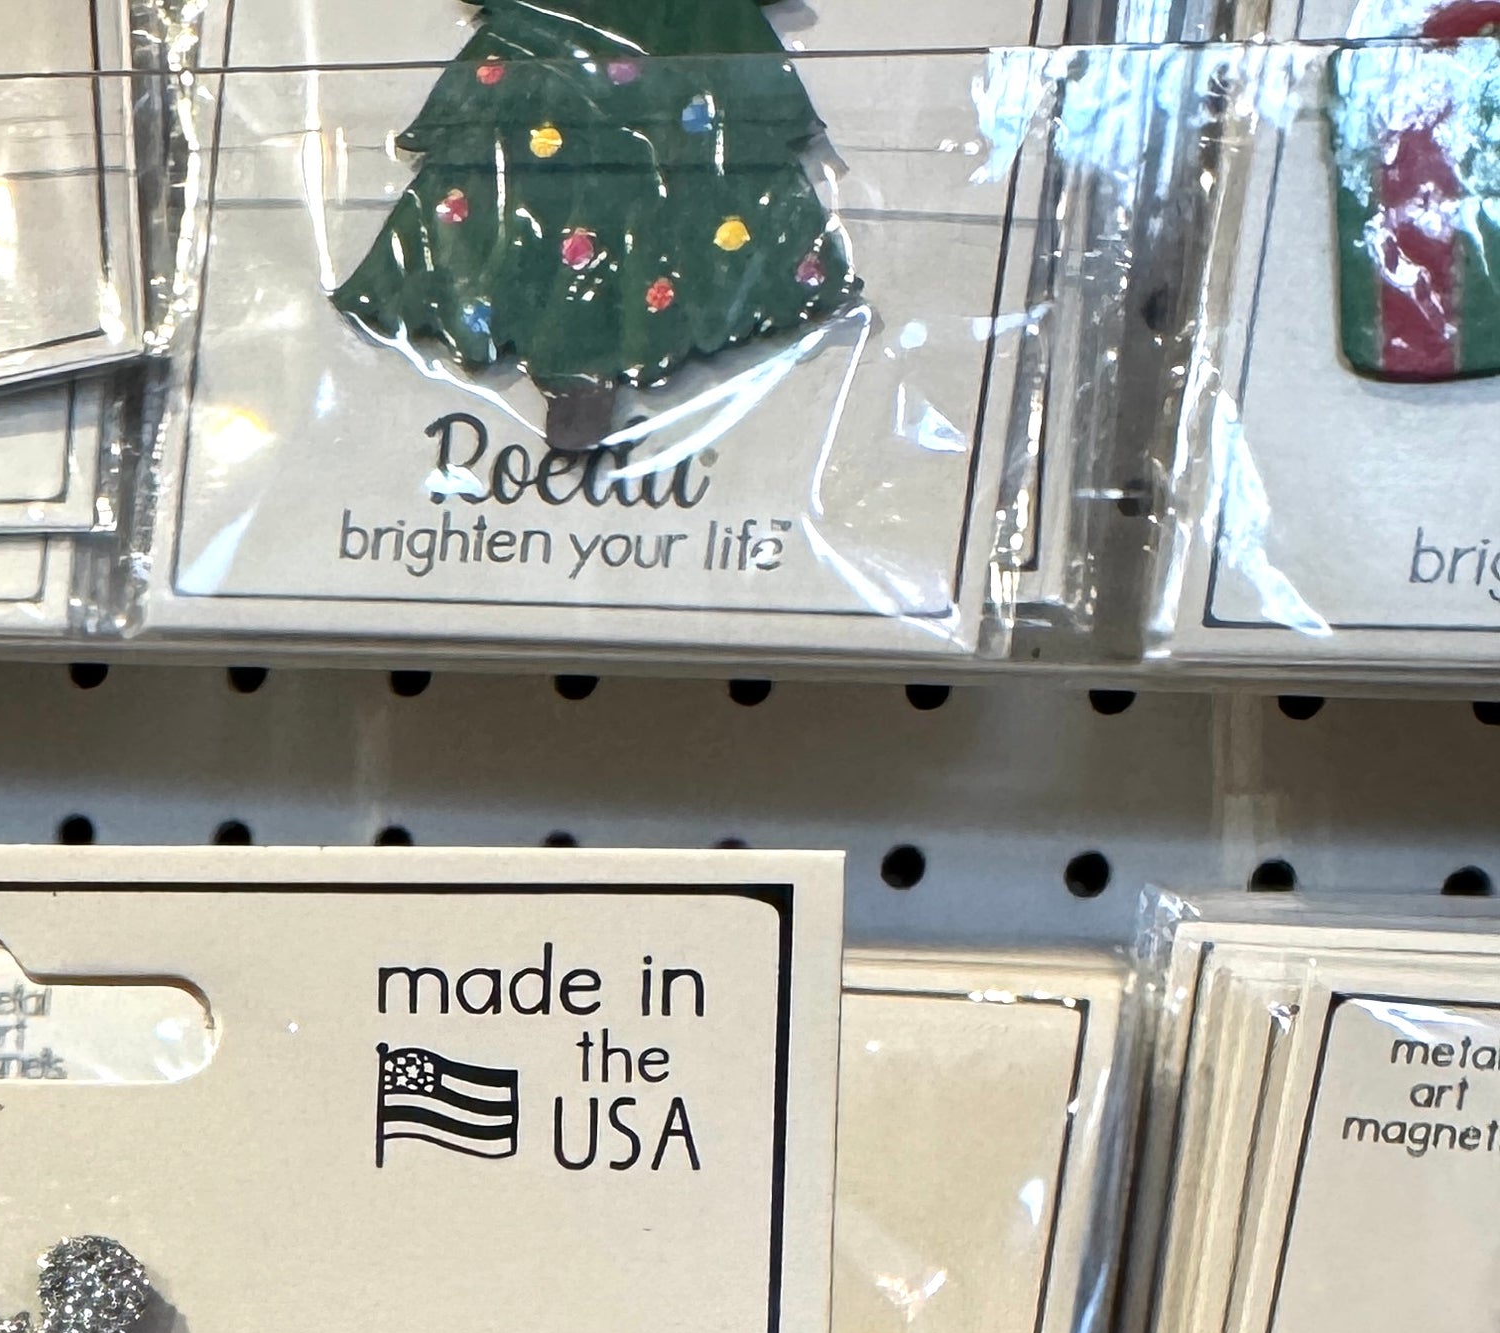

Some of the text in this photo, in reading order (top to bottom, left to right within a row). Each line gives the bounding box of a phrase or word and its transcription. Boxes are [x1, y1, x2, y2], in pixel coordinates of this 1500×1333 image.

[338, 509, 552, 578] brighten
[569, 532, 688, 580] your
[378, 942, 706, 1017] made in
[576, 1028, 670, 1084] the
[1409, 1076, 1470, 1112] art
[553, 1096, 701, 1172] USA
[1342, 1117, 1500, 1159] magnet
